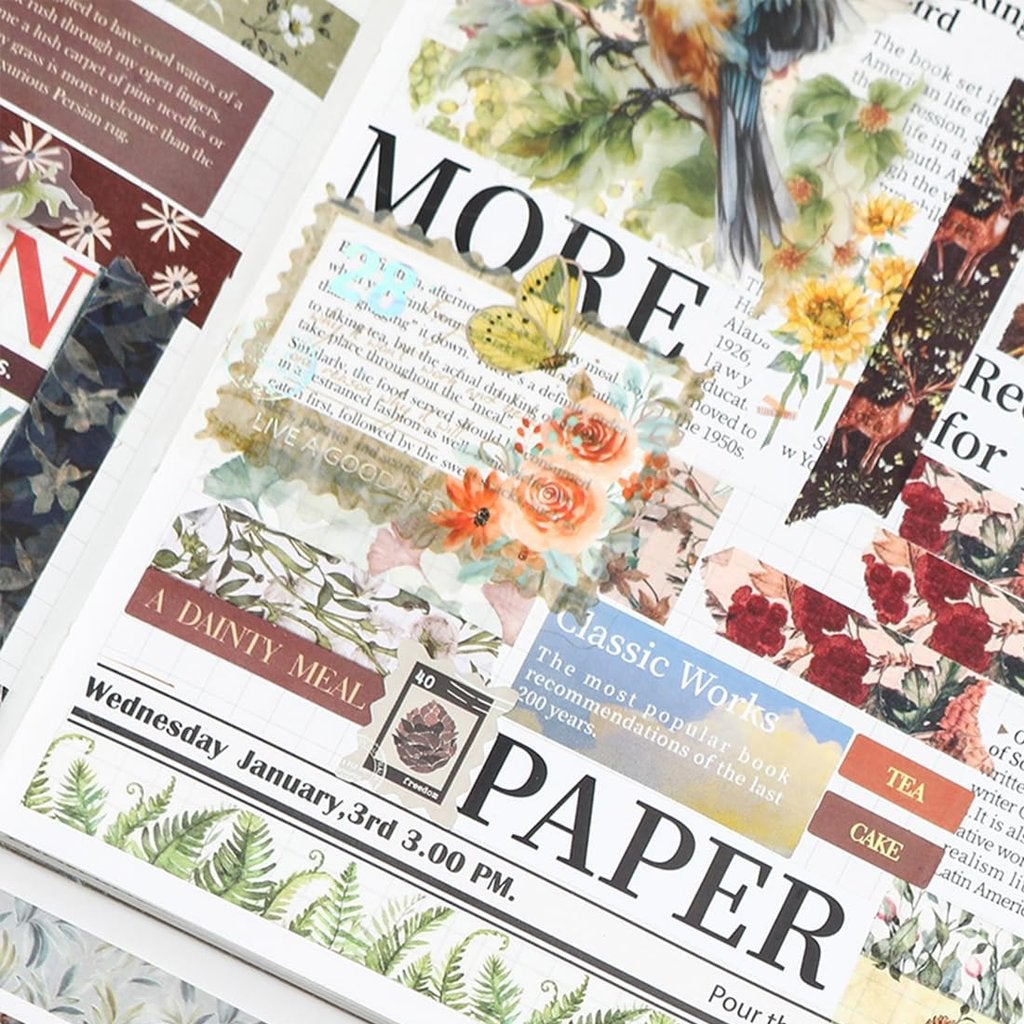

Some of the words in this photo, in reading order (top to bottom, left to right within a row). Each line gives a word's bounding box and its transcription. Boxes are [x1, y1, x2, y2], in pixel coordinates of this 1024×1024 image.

[59, 16, 113, 57] through
[114, 50, 138, 71] my
[138, 66, 174, 93] open
[92, 10, 108, 27] to
[109, 17, 142, 47] have
[143, 43, 175, 67] cool
[175, 60, 215, 94] waters
[217, 89, 238, 104] of
[233, 99, 243, 112] a
[331, 124, 710, 358] MORE
[330, 243, 418, 318] 28
[715, 334, 751, 367] 1926,
[252, 411, 300, 447] LIVE
[300, 436, 316, 456] A
[323, 446, 394, 489] GOOD
[930, 411, 1008, 472] for
[144, 588, 164, 614] A
[176, 599, 283, 665] DAINTY
[287, 653, 366, 710] MEAL
[414, 668, 436, 689] 40
[556, 601, 670, 678] Classic
[680, 659, 779, 732] Works
[517, 685, 547, 711] 200
[544, 703, 596, 738] years.
[524, 668, 690, 758] recommendations
[693, 752, 717, 769] of
[716, 761, 746, 786] the
[748, 776, 782, 805] last
[535, 645, 576, 677] The
[582, 673, 637, 708] most
[641, 703, 730, 753] popular
[737, 747, 789, 784] book
[85, 675, 229, 760] Wednesday
[401, 828, 466, 873] 3.00
[469, 862, 515, 902] PM.
[885, 766, 925, 803] TEA
[988, 744, 1011, 760] of
[970, 783, 1018, 813] writer
[456, 731, 845, 990] PAPER
[849, 822, 904, 862] CAKE
[707, 984, 763, 1023] Pour
